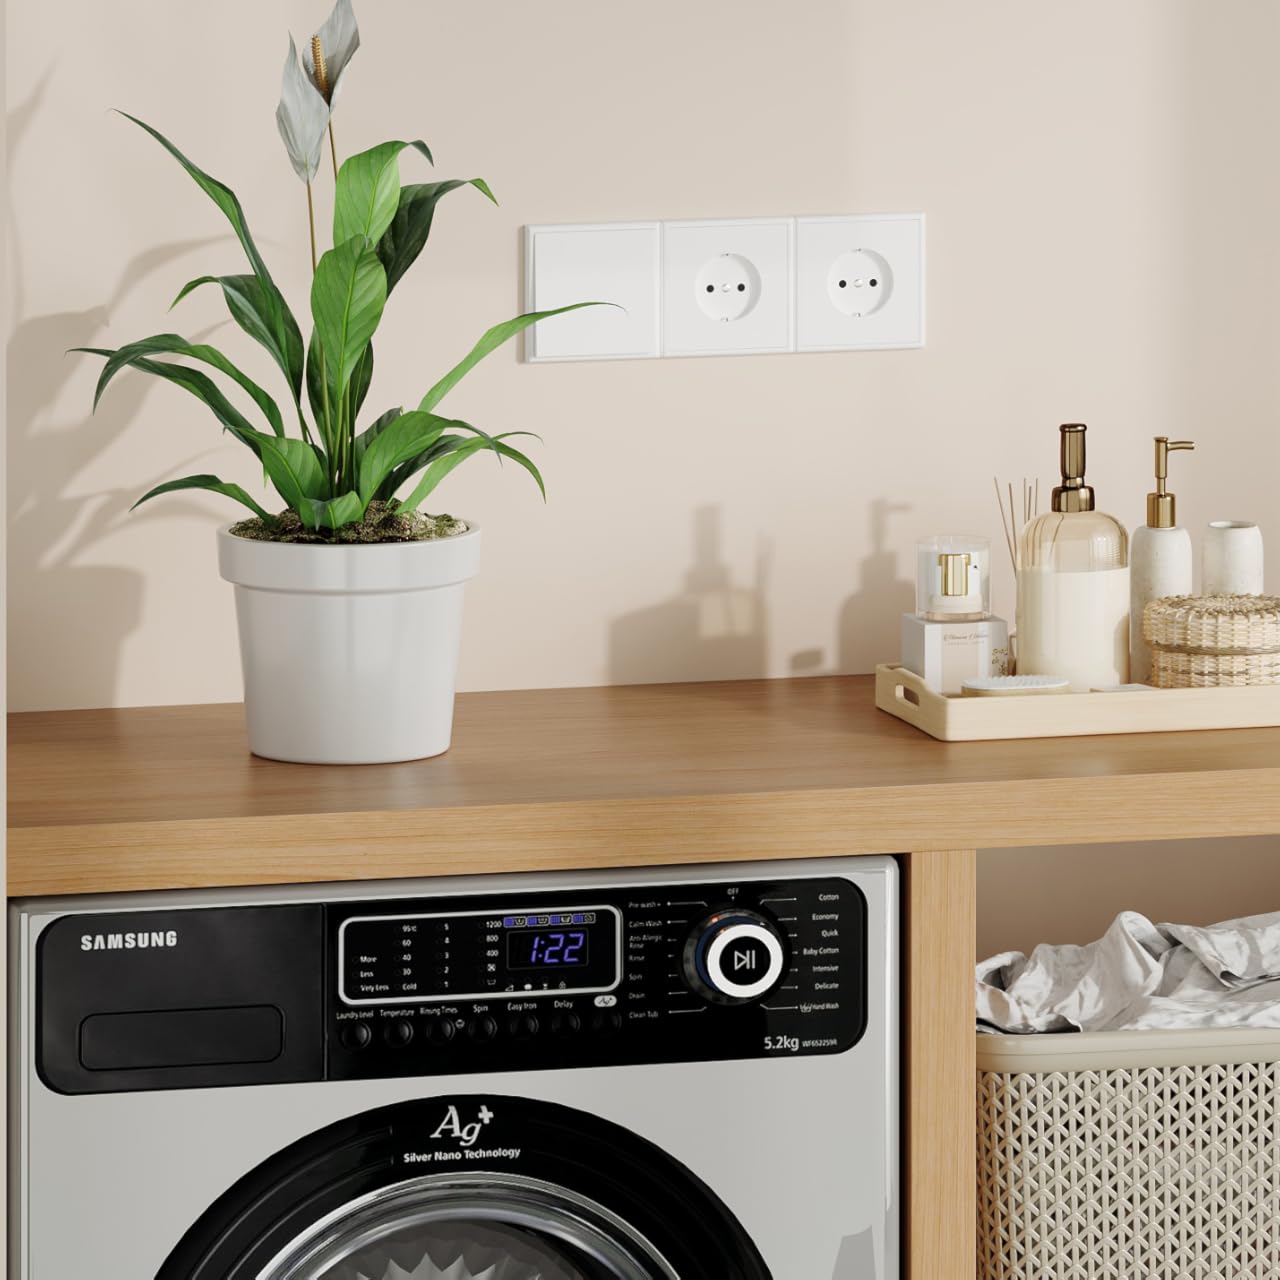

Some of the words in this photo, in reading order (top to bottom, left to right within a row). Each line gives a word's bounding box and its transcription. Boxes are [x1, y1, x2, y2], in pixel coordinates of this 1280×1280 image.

[812, 913, 839, 921] Economy
[821, 929, 839, 938] Quick
[80, 930, 177, 951] SAMSUNG
[402, 939, 411, 947] 60
[531, 933, 584, 963] 1:22
[819, 947, 839, 955] Cotton
[402, 982, 417, 990] Cold
[473, 1004, 488, 1013] Spin
[507, 1002, 523, 1011] Easy
[554, 1000, 573, 1009] Delay
[764, 1035, 799, 1051] 5.2kg
[403, 1152, 432, 1163] Silver
[434, 1151, 462, 1161] Nano
[464, 1147, 521, 1160] Technology
